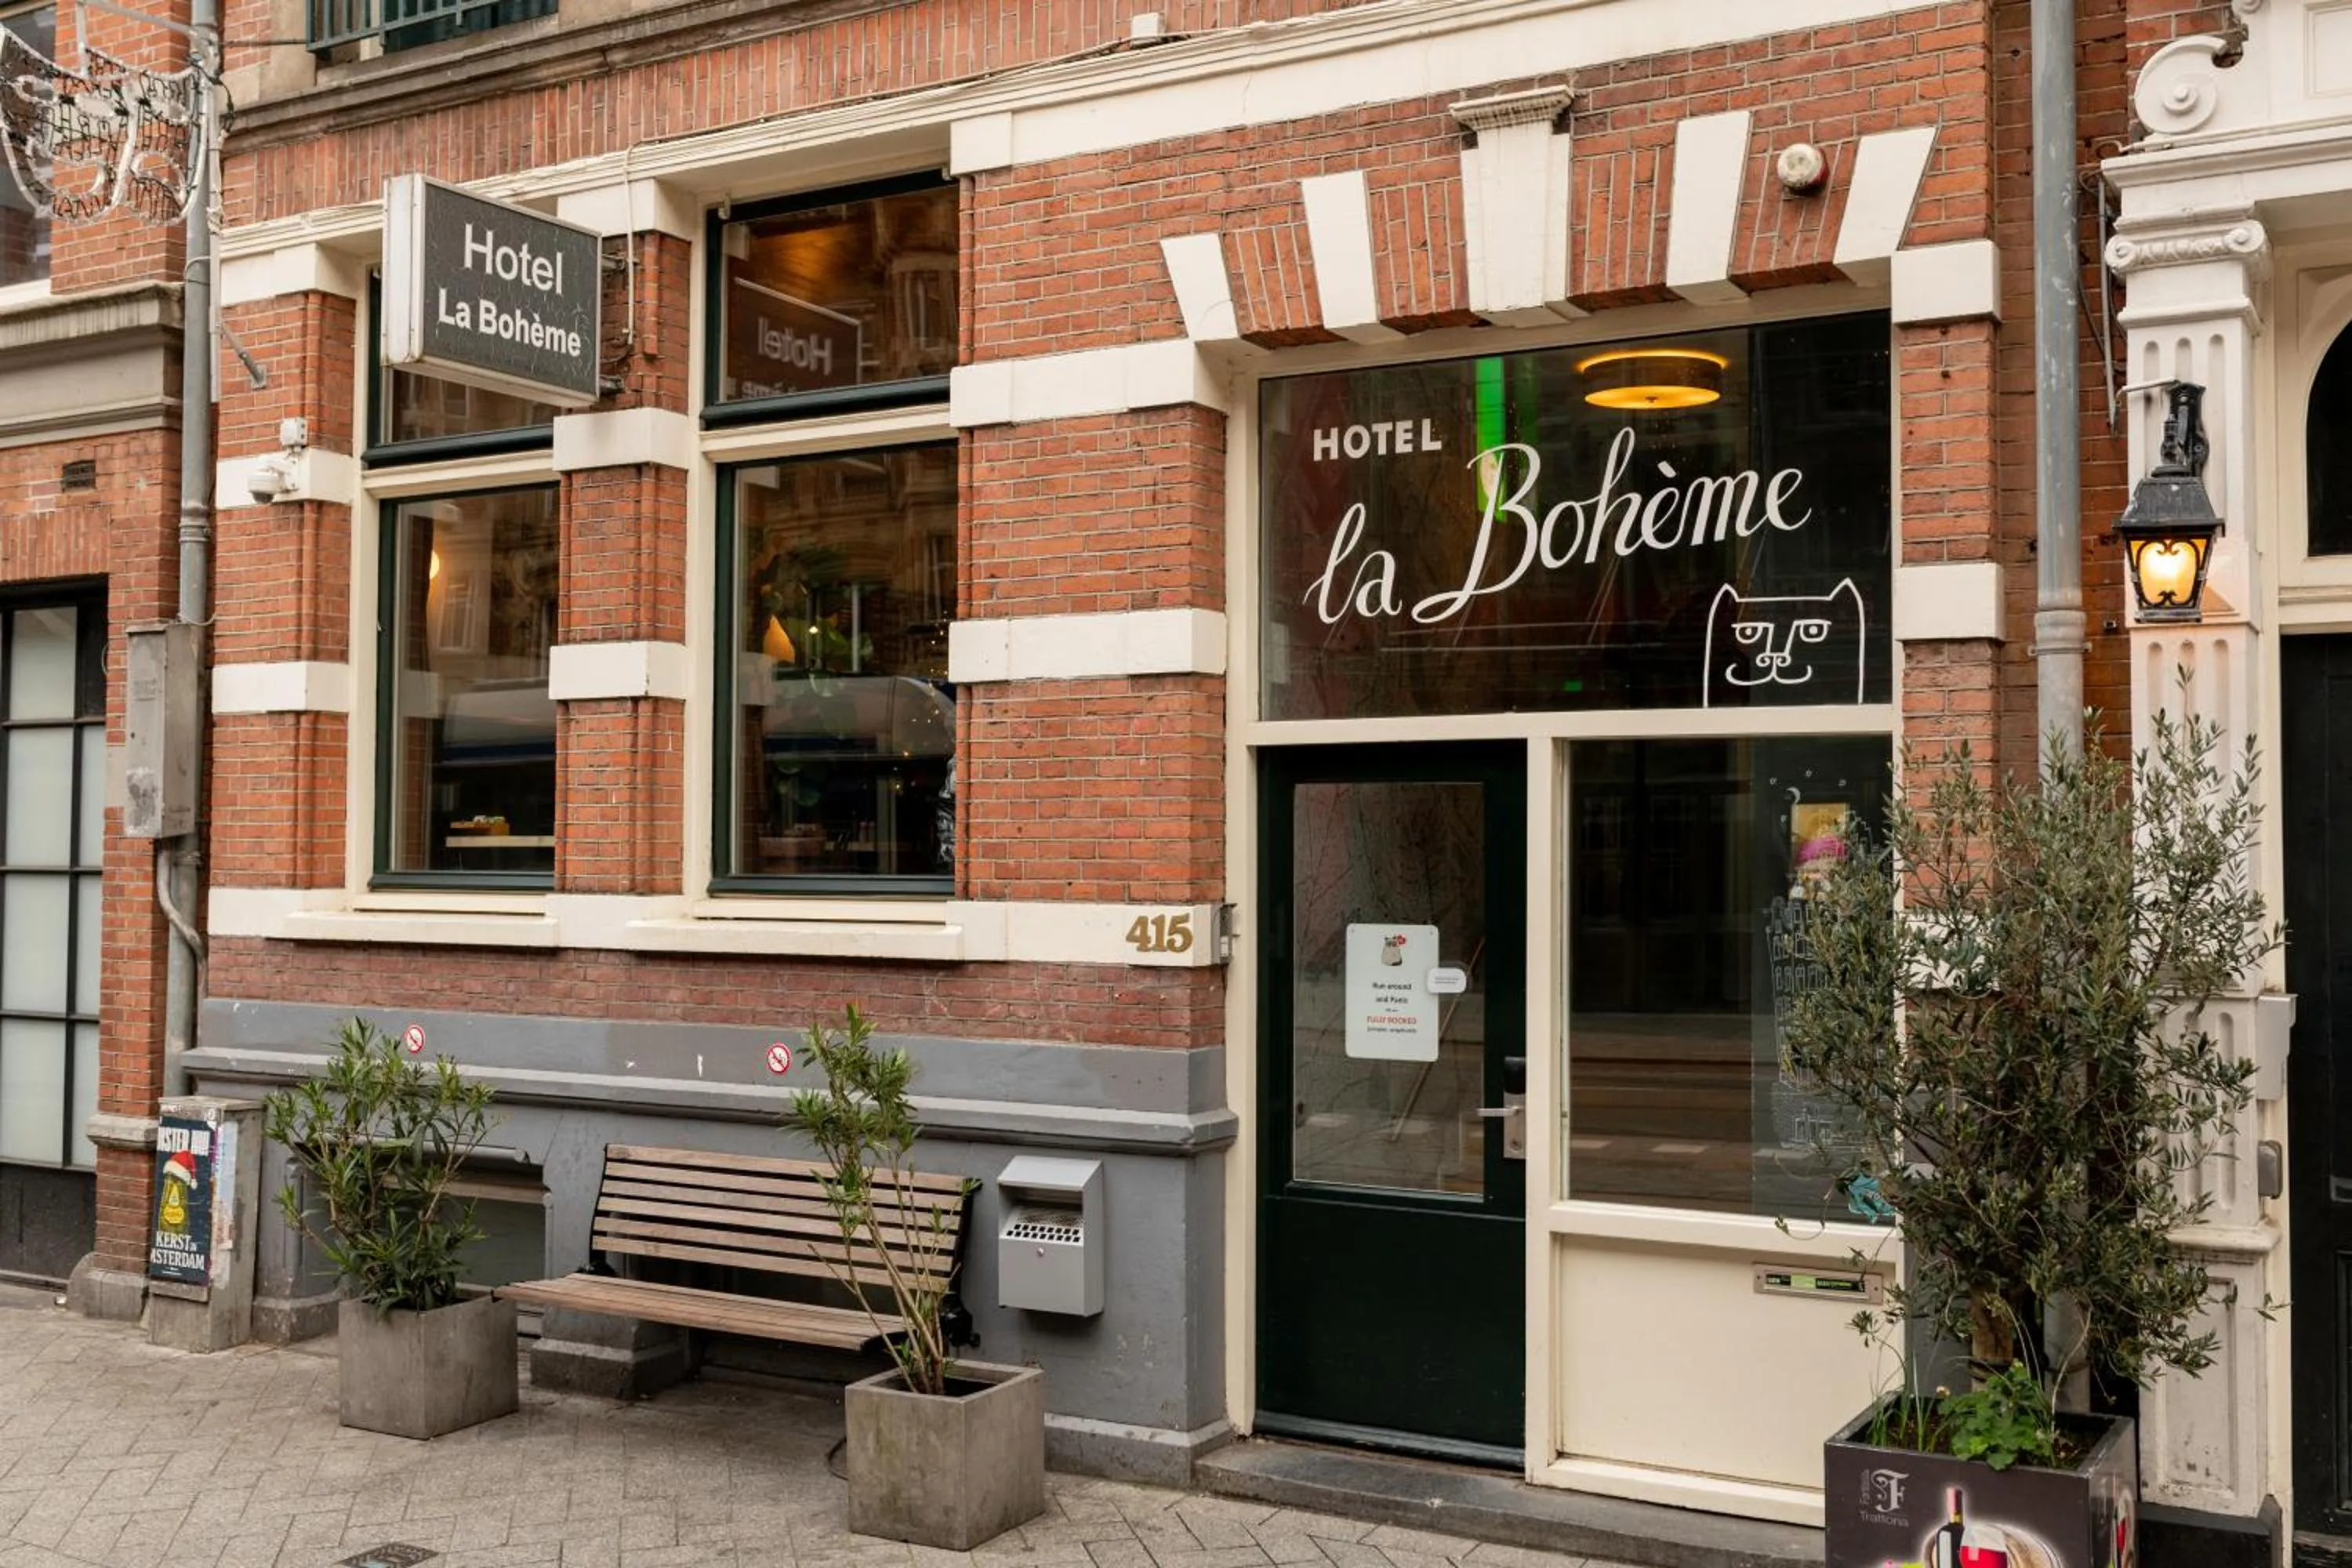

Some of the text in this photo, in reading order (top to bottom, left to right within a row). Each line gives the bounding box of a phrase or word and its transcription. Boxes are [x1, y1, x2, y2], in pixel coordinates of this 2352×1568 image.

[463, 223, 563, 296] Hotel
[438, 288, 581, 357] La Bohème
[1313, 418, 1443, 462] HOTEL
[1303, 426, 1812, 624] la Bohème
[1126, 913, 1193, 953] 415
[156, 1231, 191, 1250] KERST
